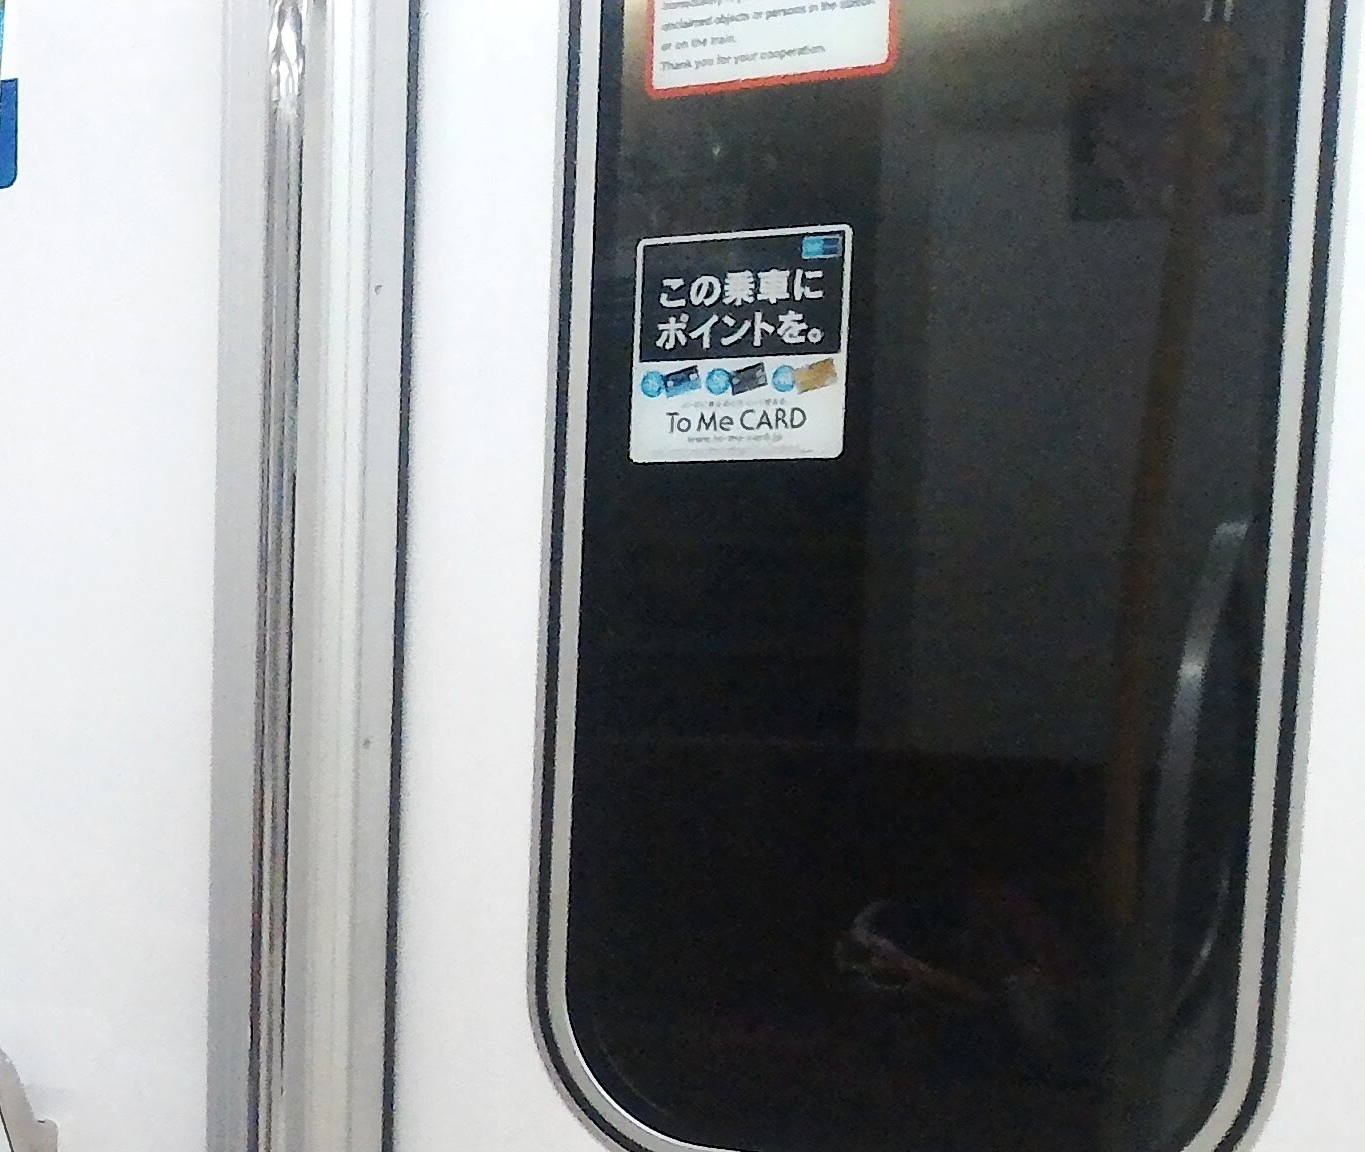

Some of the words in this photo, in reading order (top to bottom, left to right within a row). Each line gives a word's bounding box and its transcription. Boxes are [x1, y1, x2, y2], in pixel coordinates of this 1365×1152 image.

[660, 59, 692, 70] Thank
[694, 57, 714, 69] you
[717, 53, 731, 64] for
[734, 52, 758, 64] your
[659, 269, 824, 308] この乗車に
[655, 309, 825, 350] ポイントを。
[665, 411, 691, 434] To
[696, 411, 734, 432] Me
[740, 407, 807, 431] CARD
